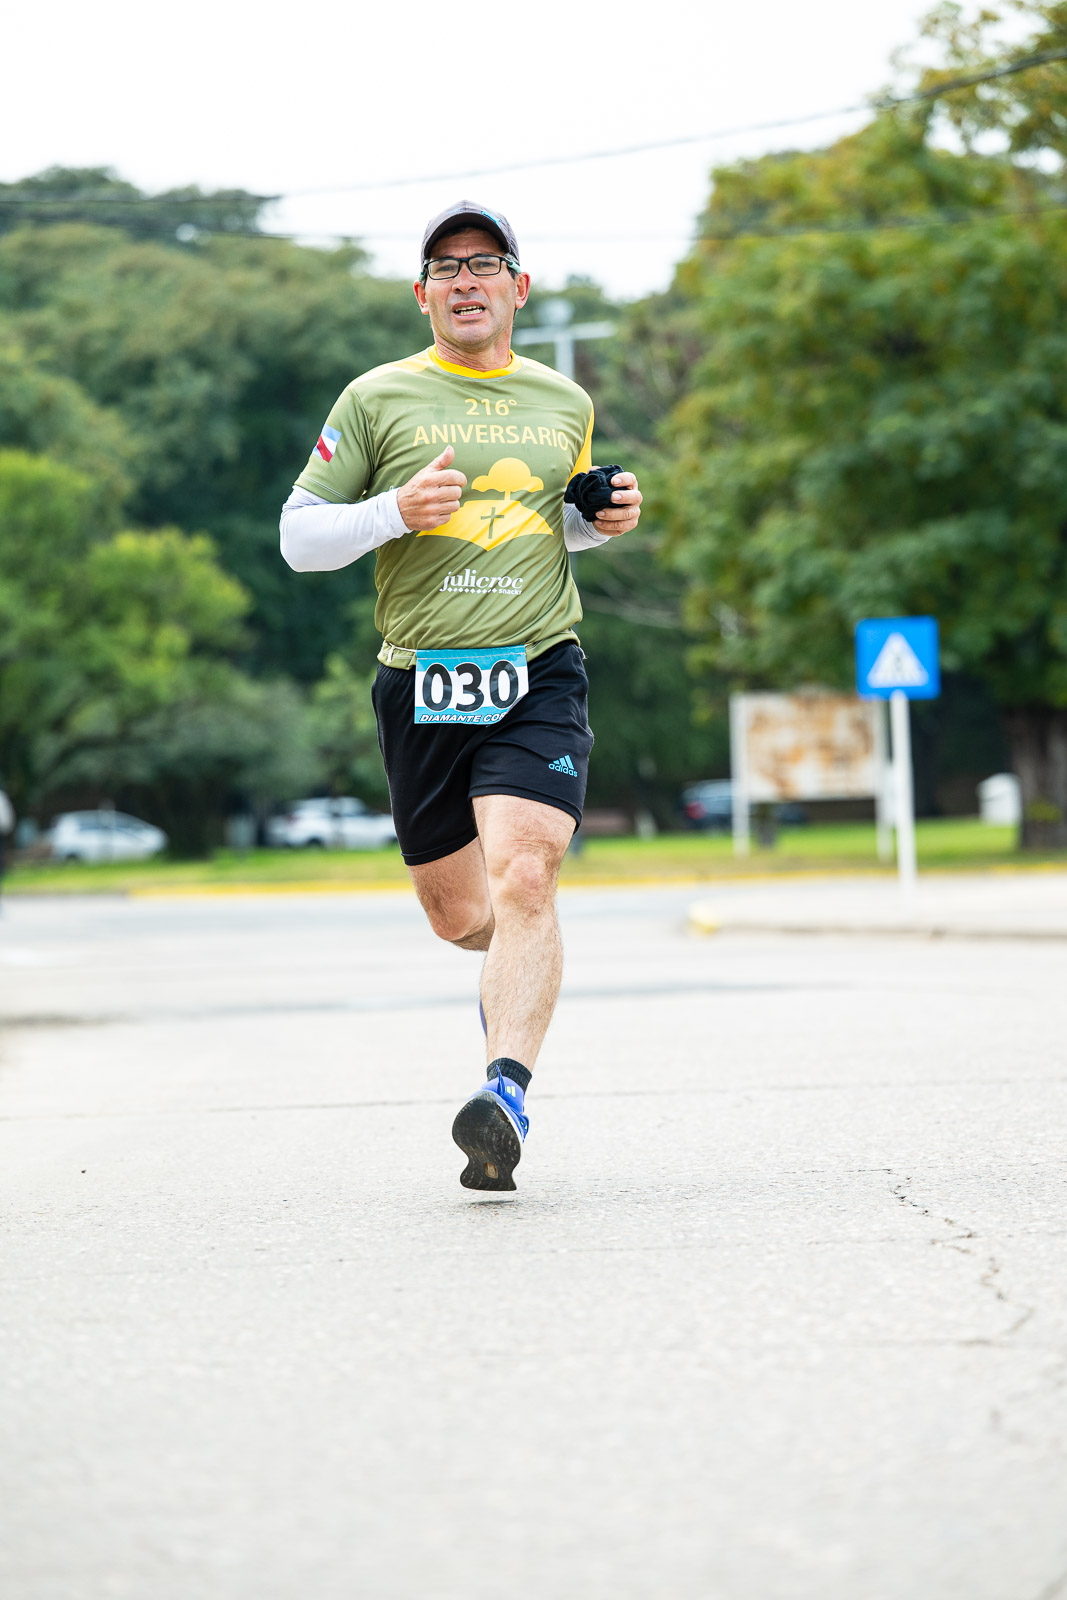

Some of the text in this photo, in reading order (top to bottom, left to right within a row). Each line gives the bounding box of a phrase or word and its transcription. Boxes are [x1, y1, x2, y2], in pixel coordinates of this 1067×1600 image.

[412, 423, 569, 451] ANIVERSARIO
[439, 568, 524, 592] julicroc
[422, 659, 519, 712] 030
[419, 713, 481, 723] DIAMANTE
[548, 763, 578, 777] adidas
